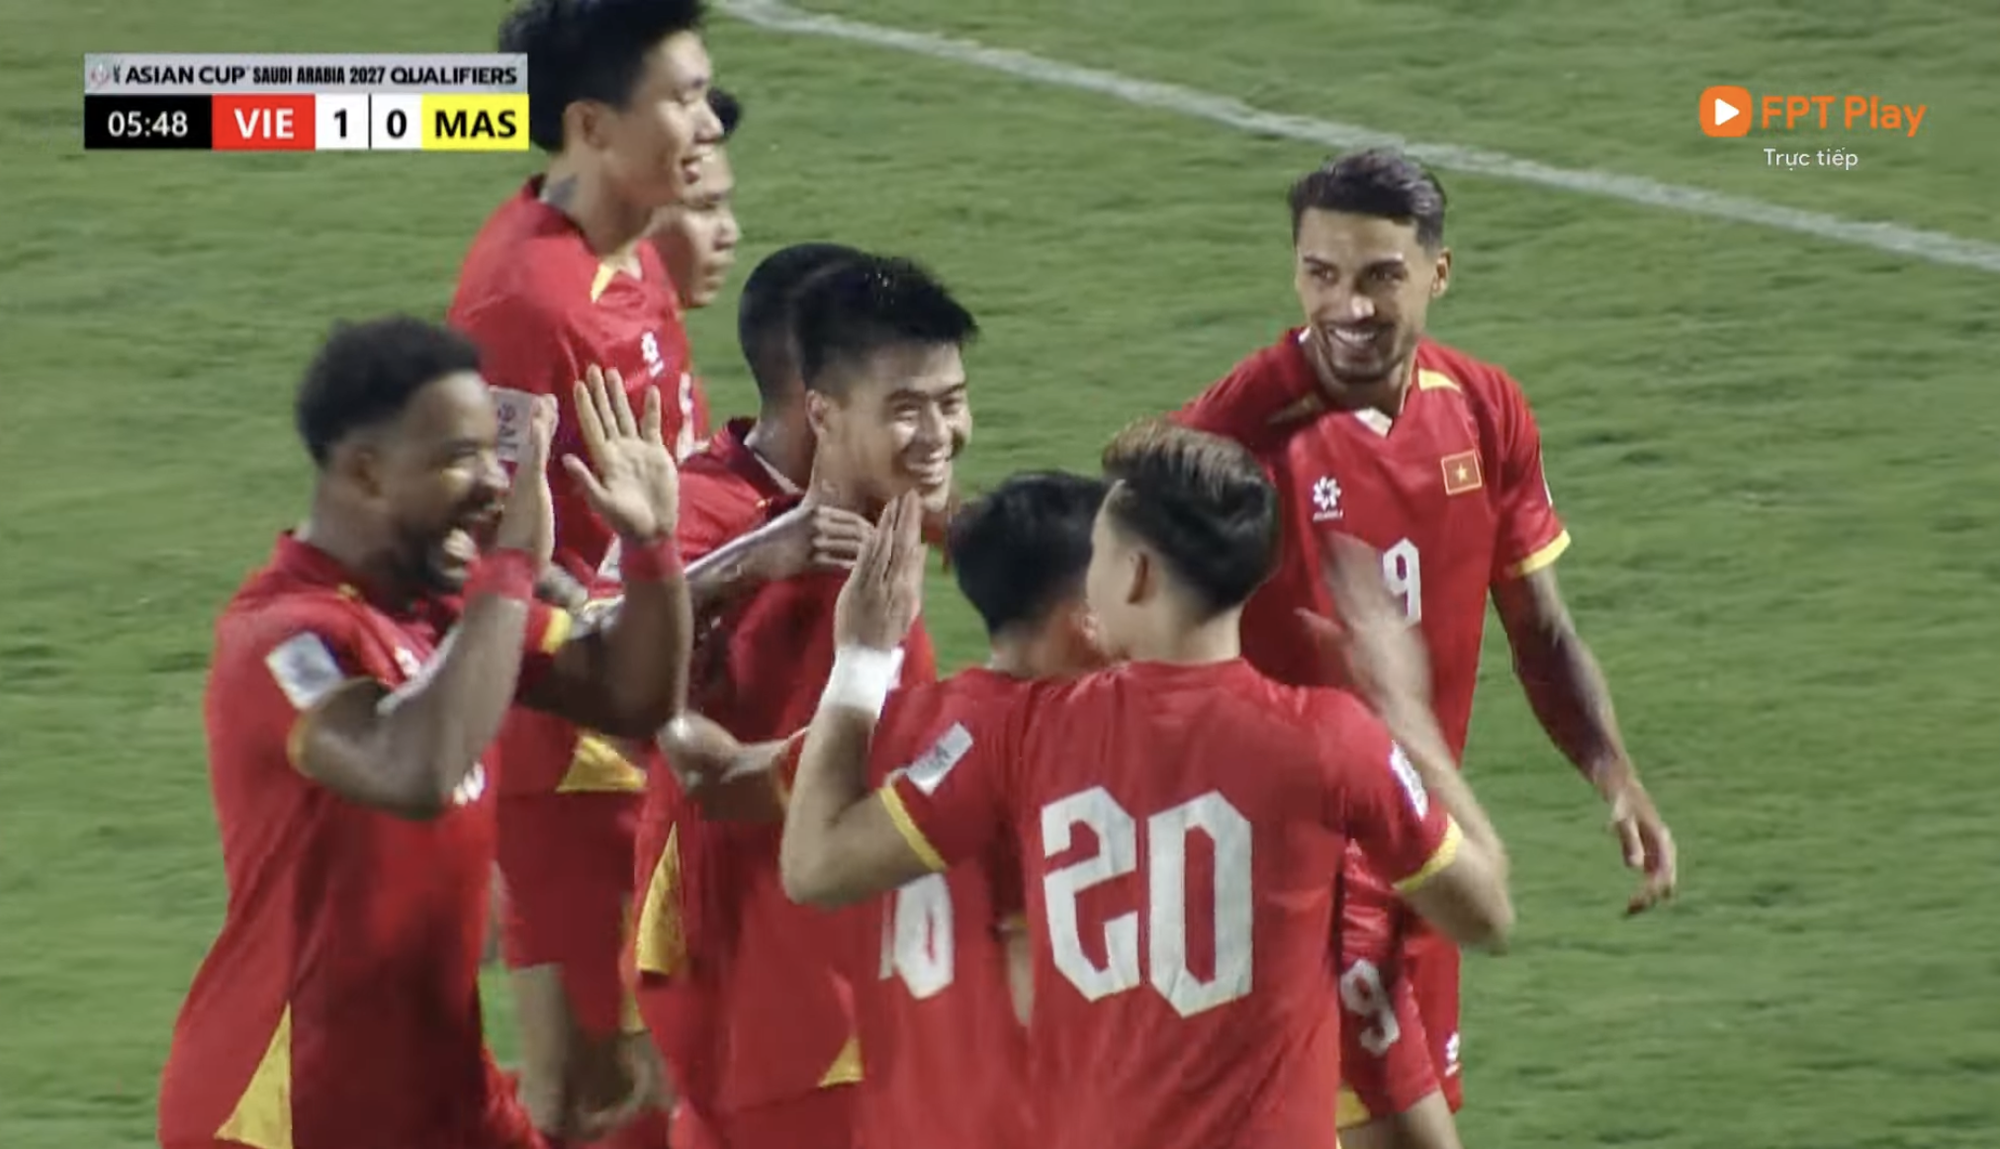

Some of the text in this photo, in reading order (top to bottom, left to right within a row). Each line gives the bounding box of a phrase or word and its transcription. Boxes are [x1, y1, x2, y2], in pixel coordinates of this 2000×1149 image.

[1382, 537, 1422, 624] 9
[1041, 785, 1253, 1019] 20
[1341, 957, 1401, 1058] 9
